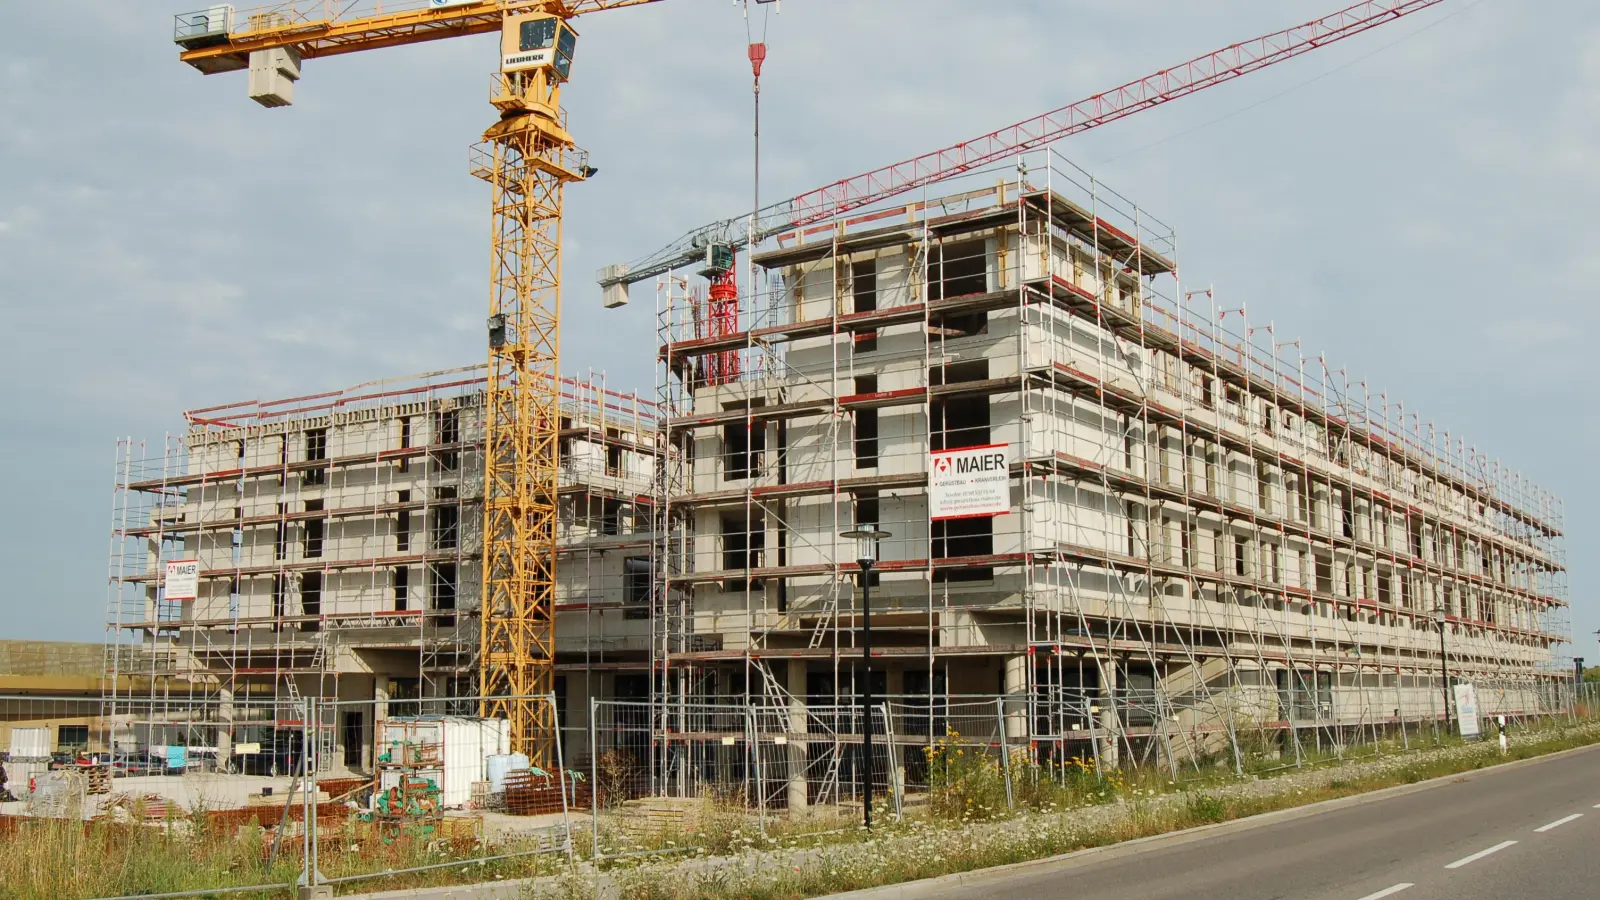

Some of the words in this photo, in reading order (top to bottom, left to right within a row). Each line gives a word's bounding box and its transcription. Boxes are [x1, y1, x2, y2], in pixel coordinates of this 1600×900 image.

[506, 54, 544, 64] LIEBHERR
[957, 453, 1005, 474] MAIER
[177, 565, 196, 575] MAIER
